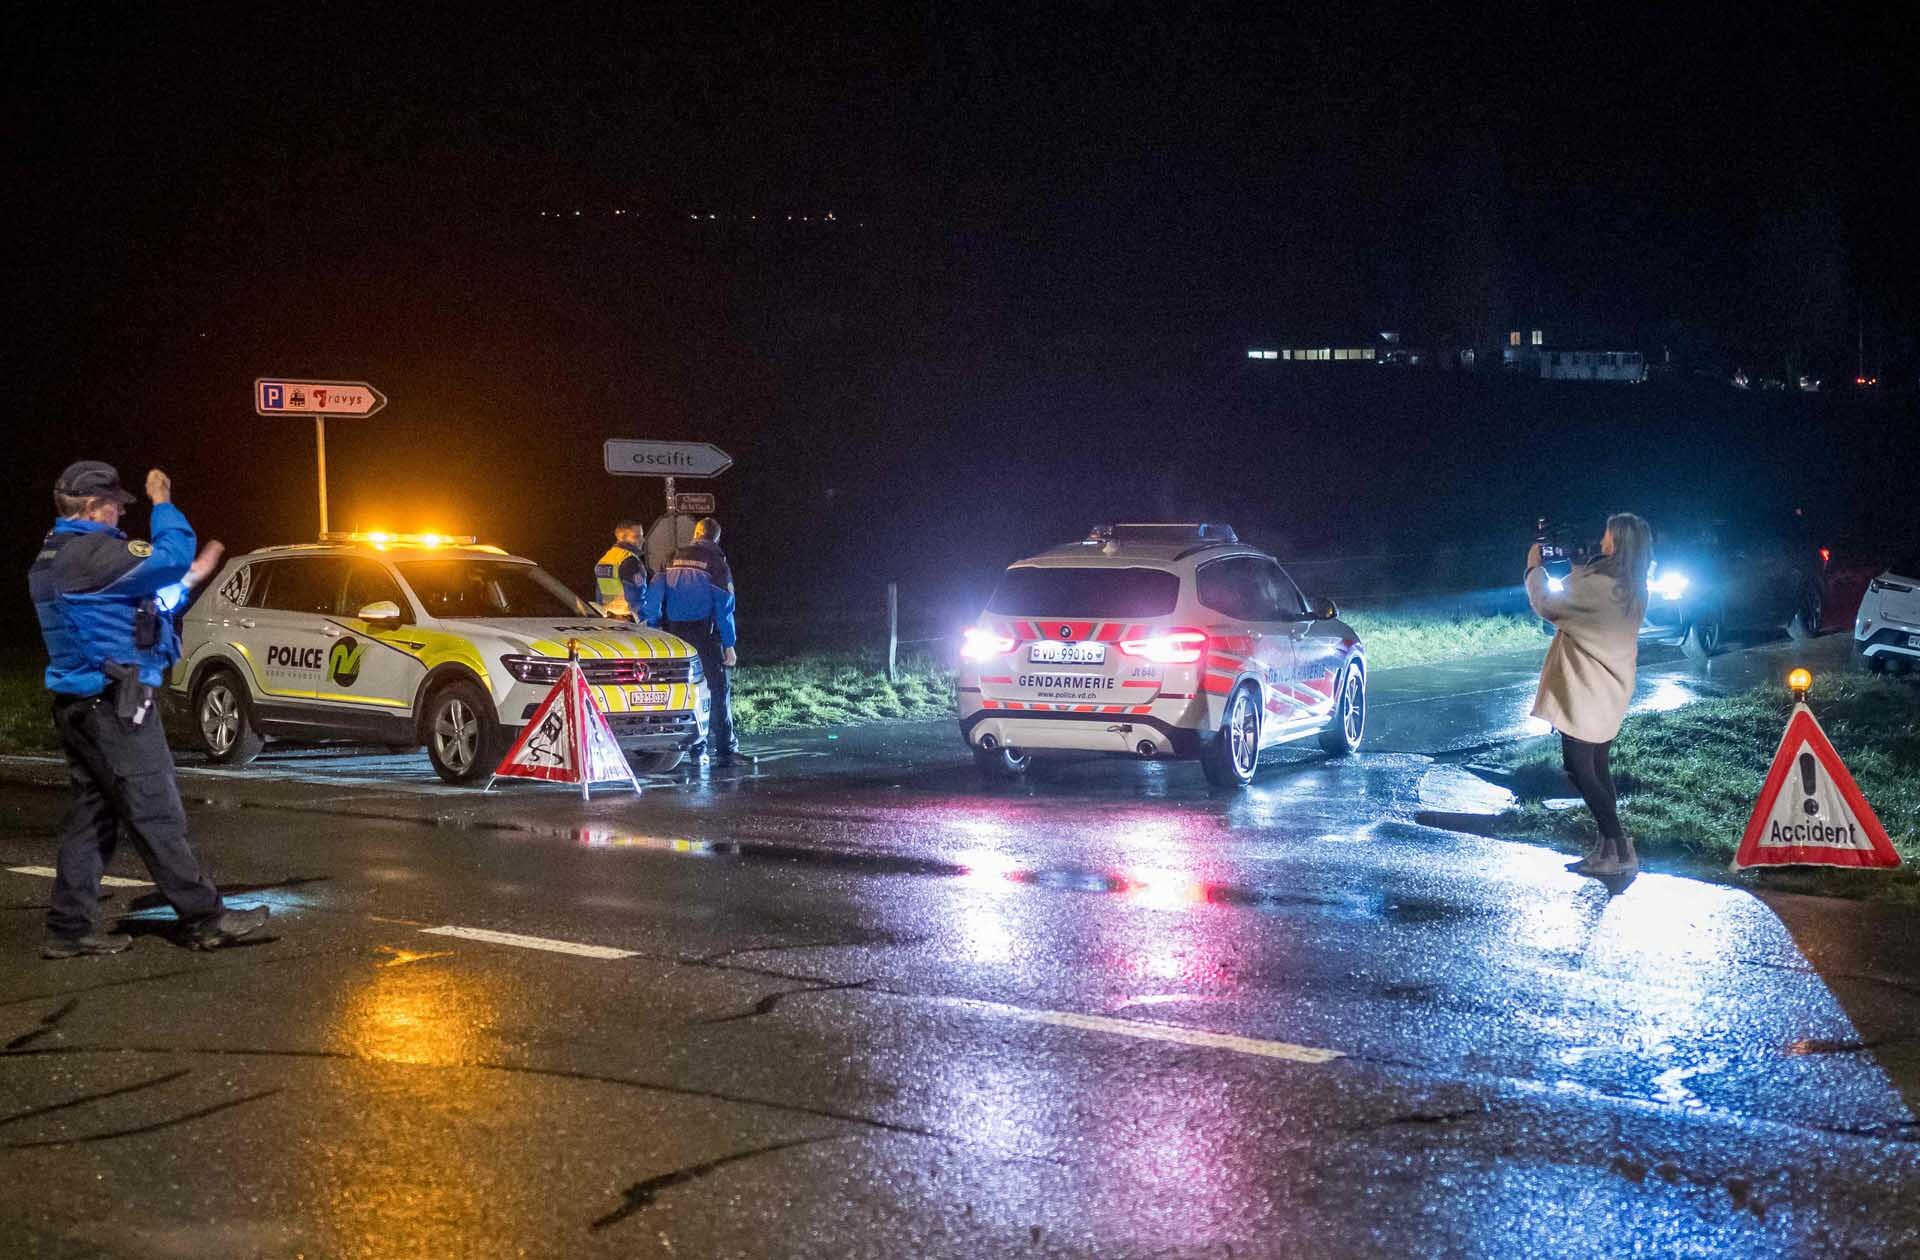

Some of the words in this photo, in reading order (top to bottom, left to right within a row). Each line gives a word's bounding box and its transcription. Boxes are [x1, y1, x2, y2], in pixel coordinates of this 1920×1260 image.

[268, 388, 279, 406] P
[267, 645, 323, 669] POLICE
[1018, 674, 1115, 690] GENDARMERIE
[1037, 691, 1097, 700] www.police.vd.ch
[1770, 820, 1857, 845] Accident
